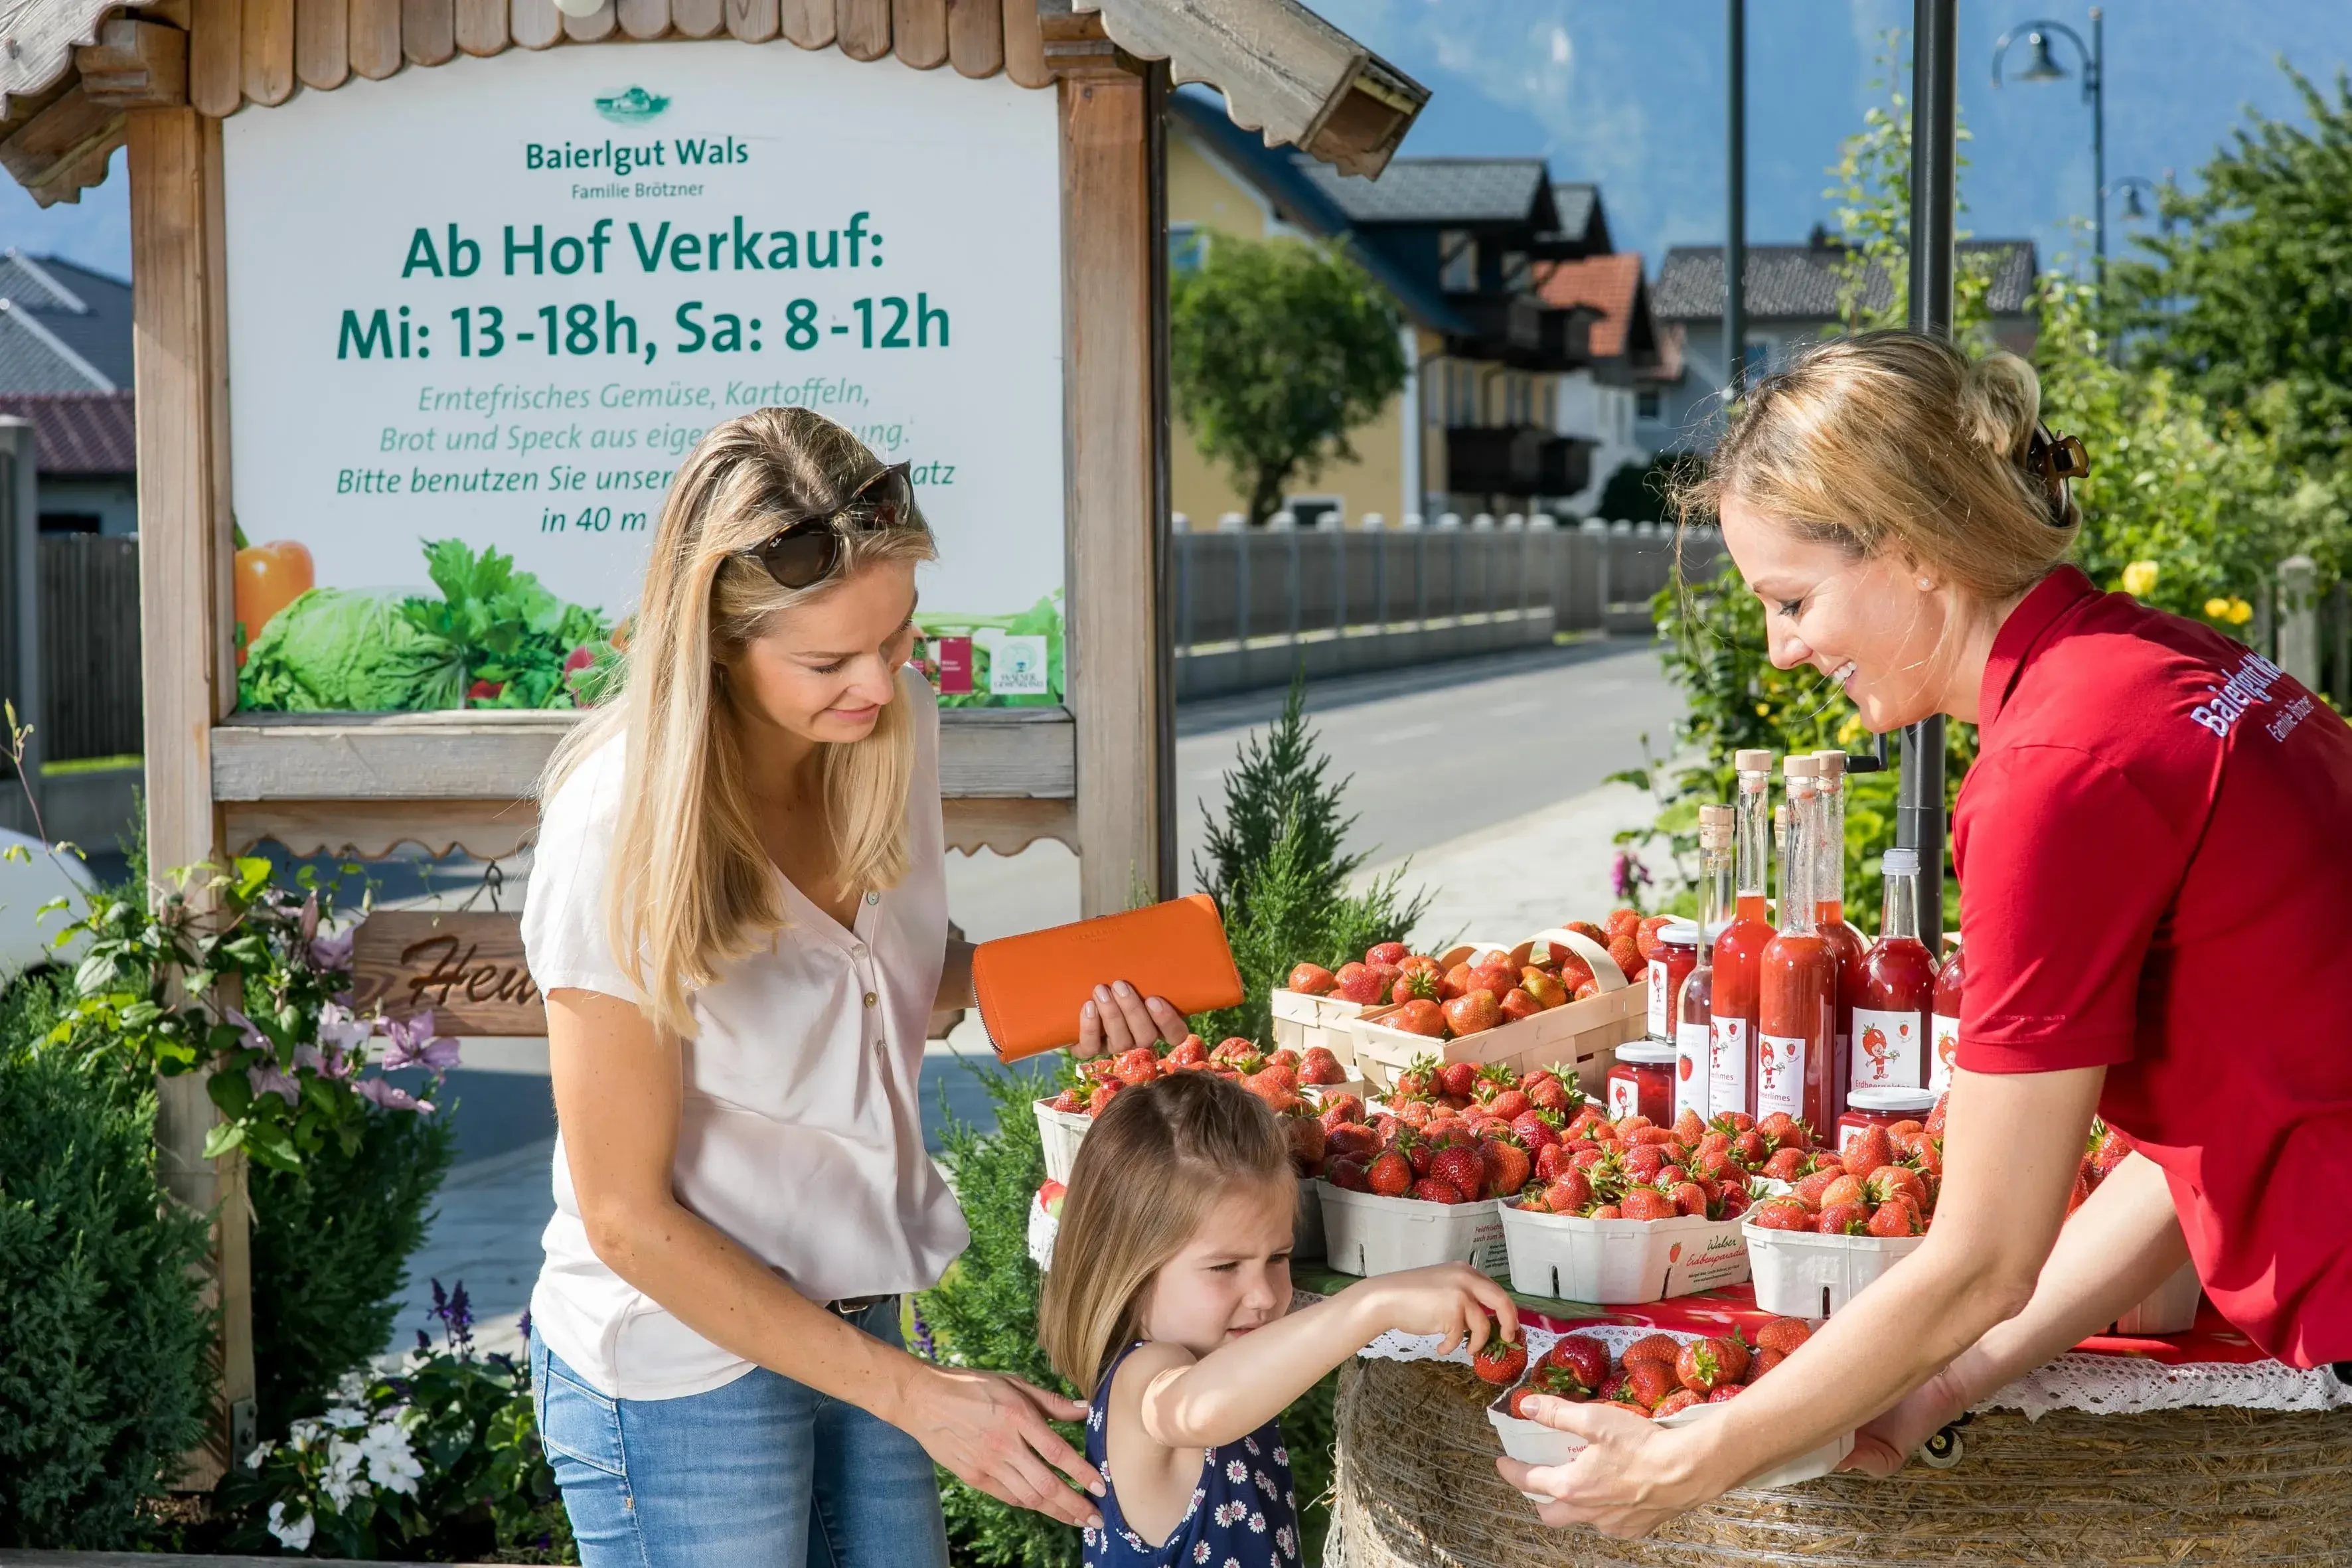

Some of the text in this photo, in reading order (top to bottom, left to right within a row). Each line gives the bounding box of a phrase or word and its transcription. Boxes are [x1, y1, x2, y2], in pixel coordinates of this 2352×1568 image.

[526, 135, 749, 176] Baierlgut Wals
[572, 180, 704, 200] Familie Brötzner
[401, 211, 884, 278] Ab Hof Verkauf:
[337, 305, 430, 360] Mi:
[676, 301, 761, 353] Sa:
[418, 376, 870, 419] Erntefrisches Gemüse, Kartoffeln,
[380, 422, 909, 457] Brot und Speck aus eige ung.
[337, 461, 956, 495] Bitte benutzen Sie unser atz
[542, 507, 647, 532] in 40 m
[400, 934, 544, 1007] Heu
